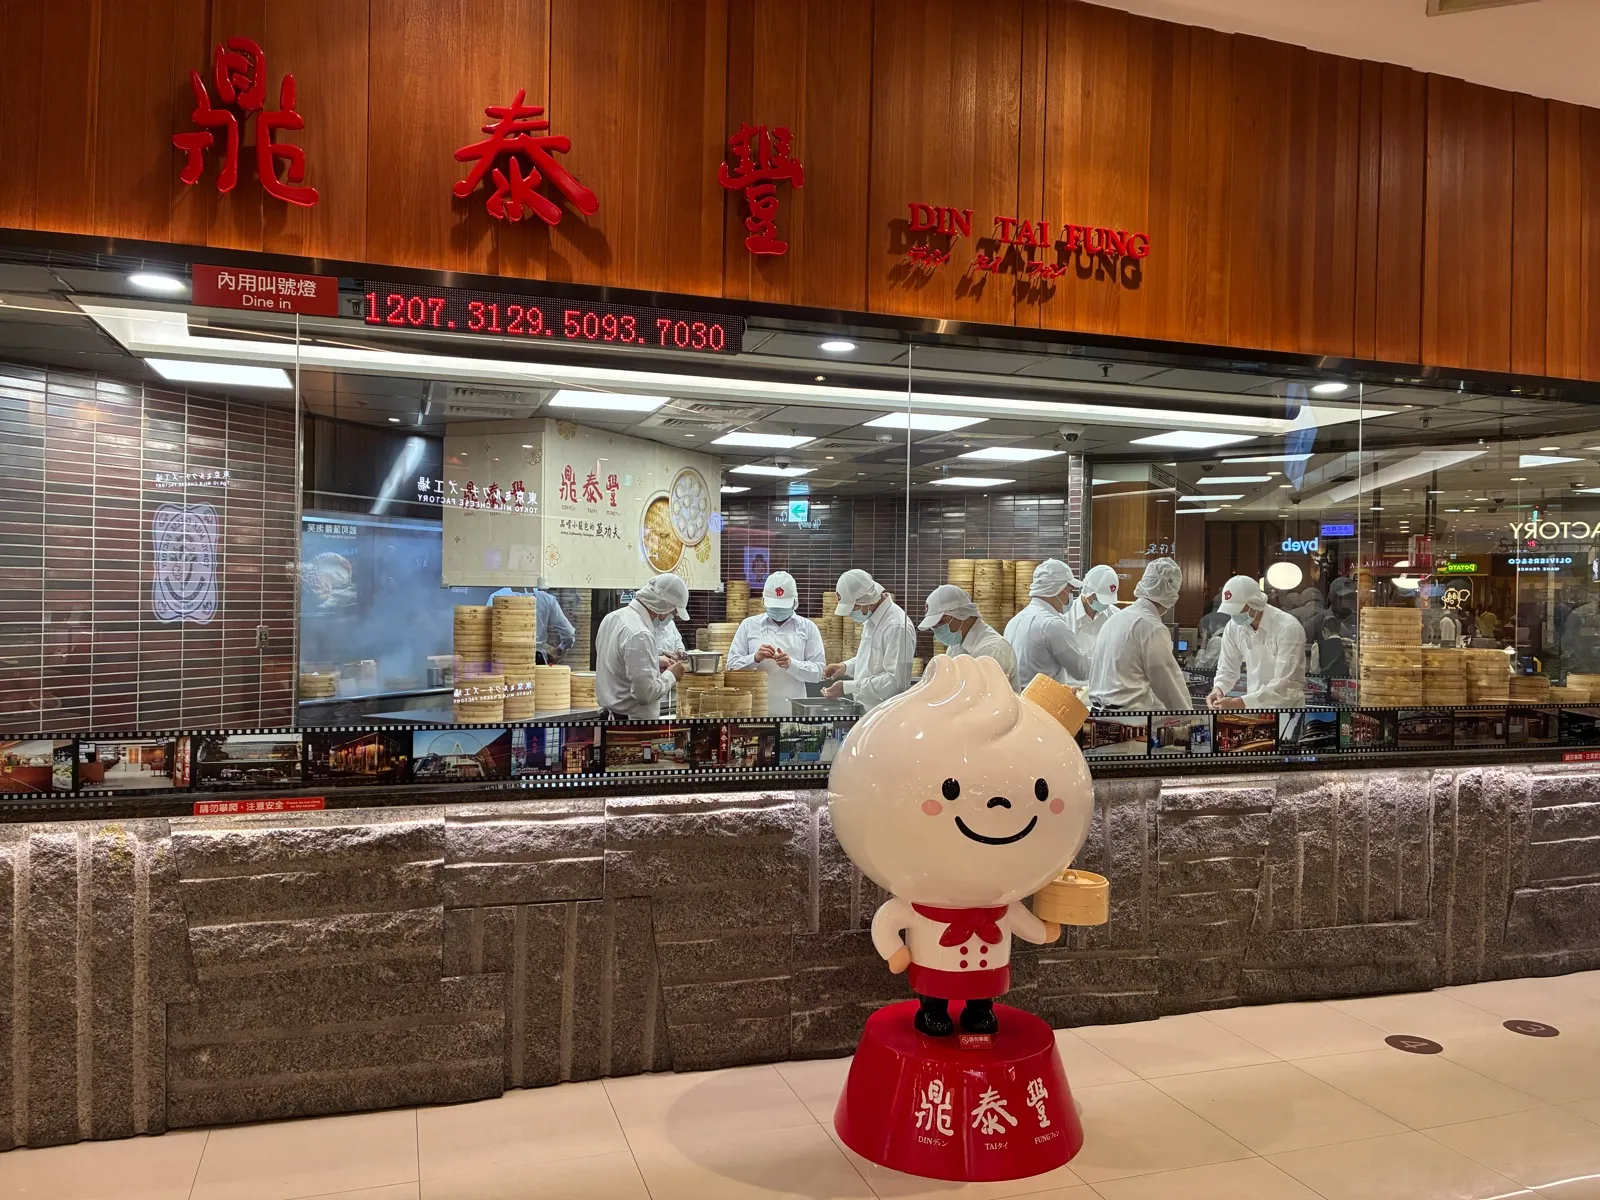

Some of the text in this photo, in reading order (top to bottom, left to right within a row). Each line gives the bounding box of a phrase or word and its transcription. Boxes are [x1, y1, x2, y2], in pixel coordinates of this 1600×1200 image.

[173, 37, 805, 256] 鼎泰豐
[908, 202, 1151, 259] DIN TAI FUNG
[242, 294, 292, 311] Dine in
[559, 464, 620, 507] 鼎泰豐
[915, 1078, 1051, 1136] 鼎泰豐
